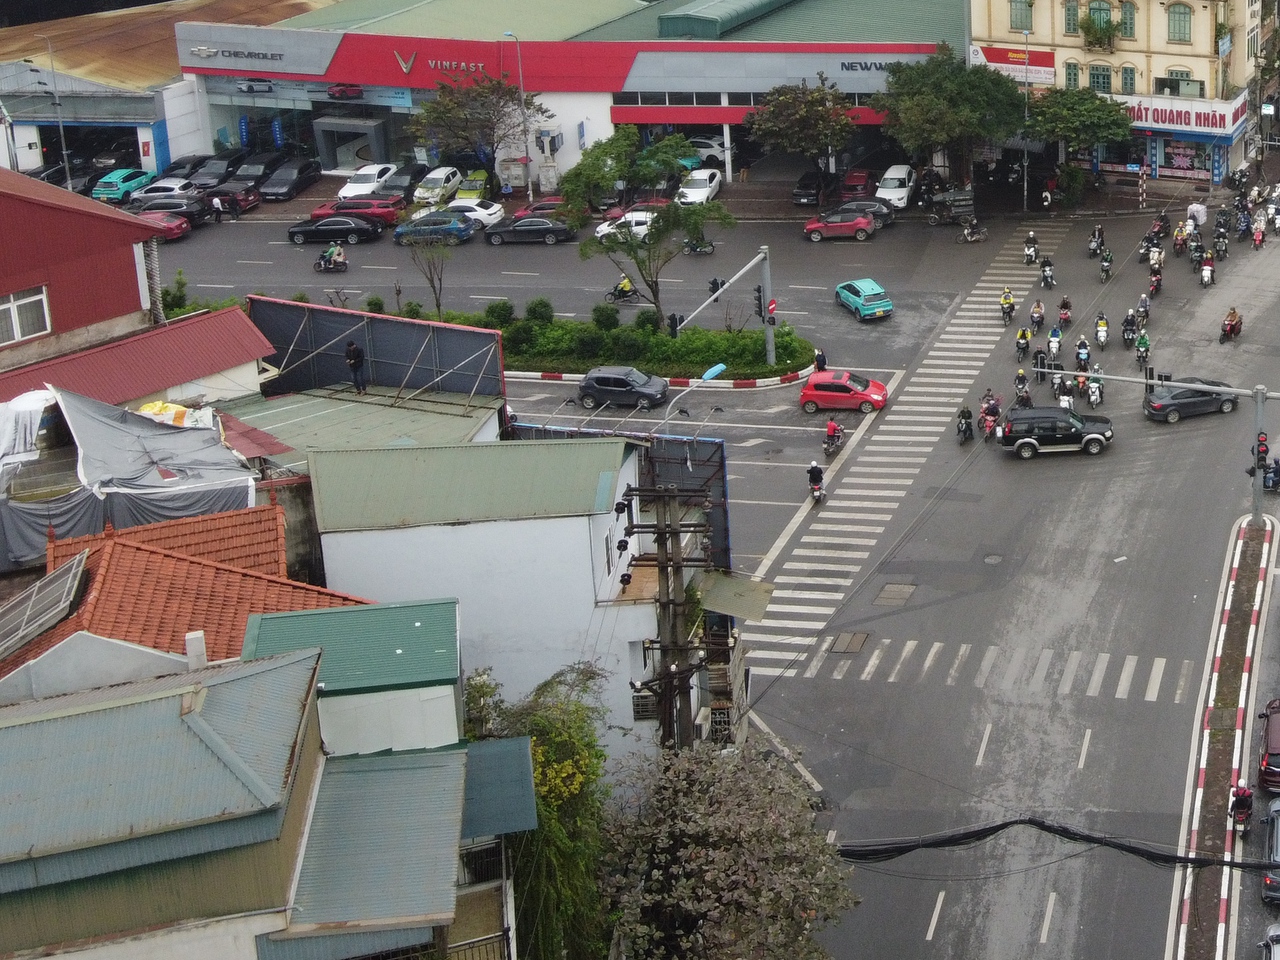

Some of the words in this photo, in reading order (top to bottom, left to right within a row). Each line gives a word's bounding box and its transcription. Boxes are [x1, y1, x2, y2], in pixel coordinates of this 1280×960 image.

[221, 50, 284, 61] CHEVROLET
[428, 58, 485, 73] VINFAST
[1126, 100, 1149, 123] MẮT
[1152, 107, 1191, 126] QUANG
[1195, 110, 1226, 129] NHÃN
